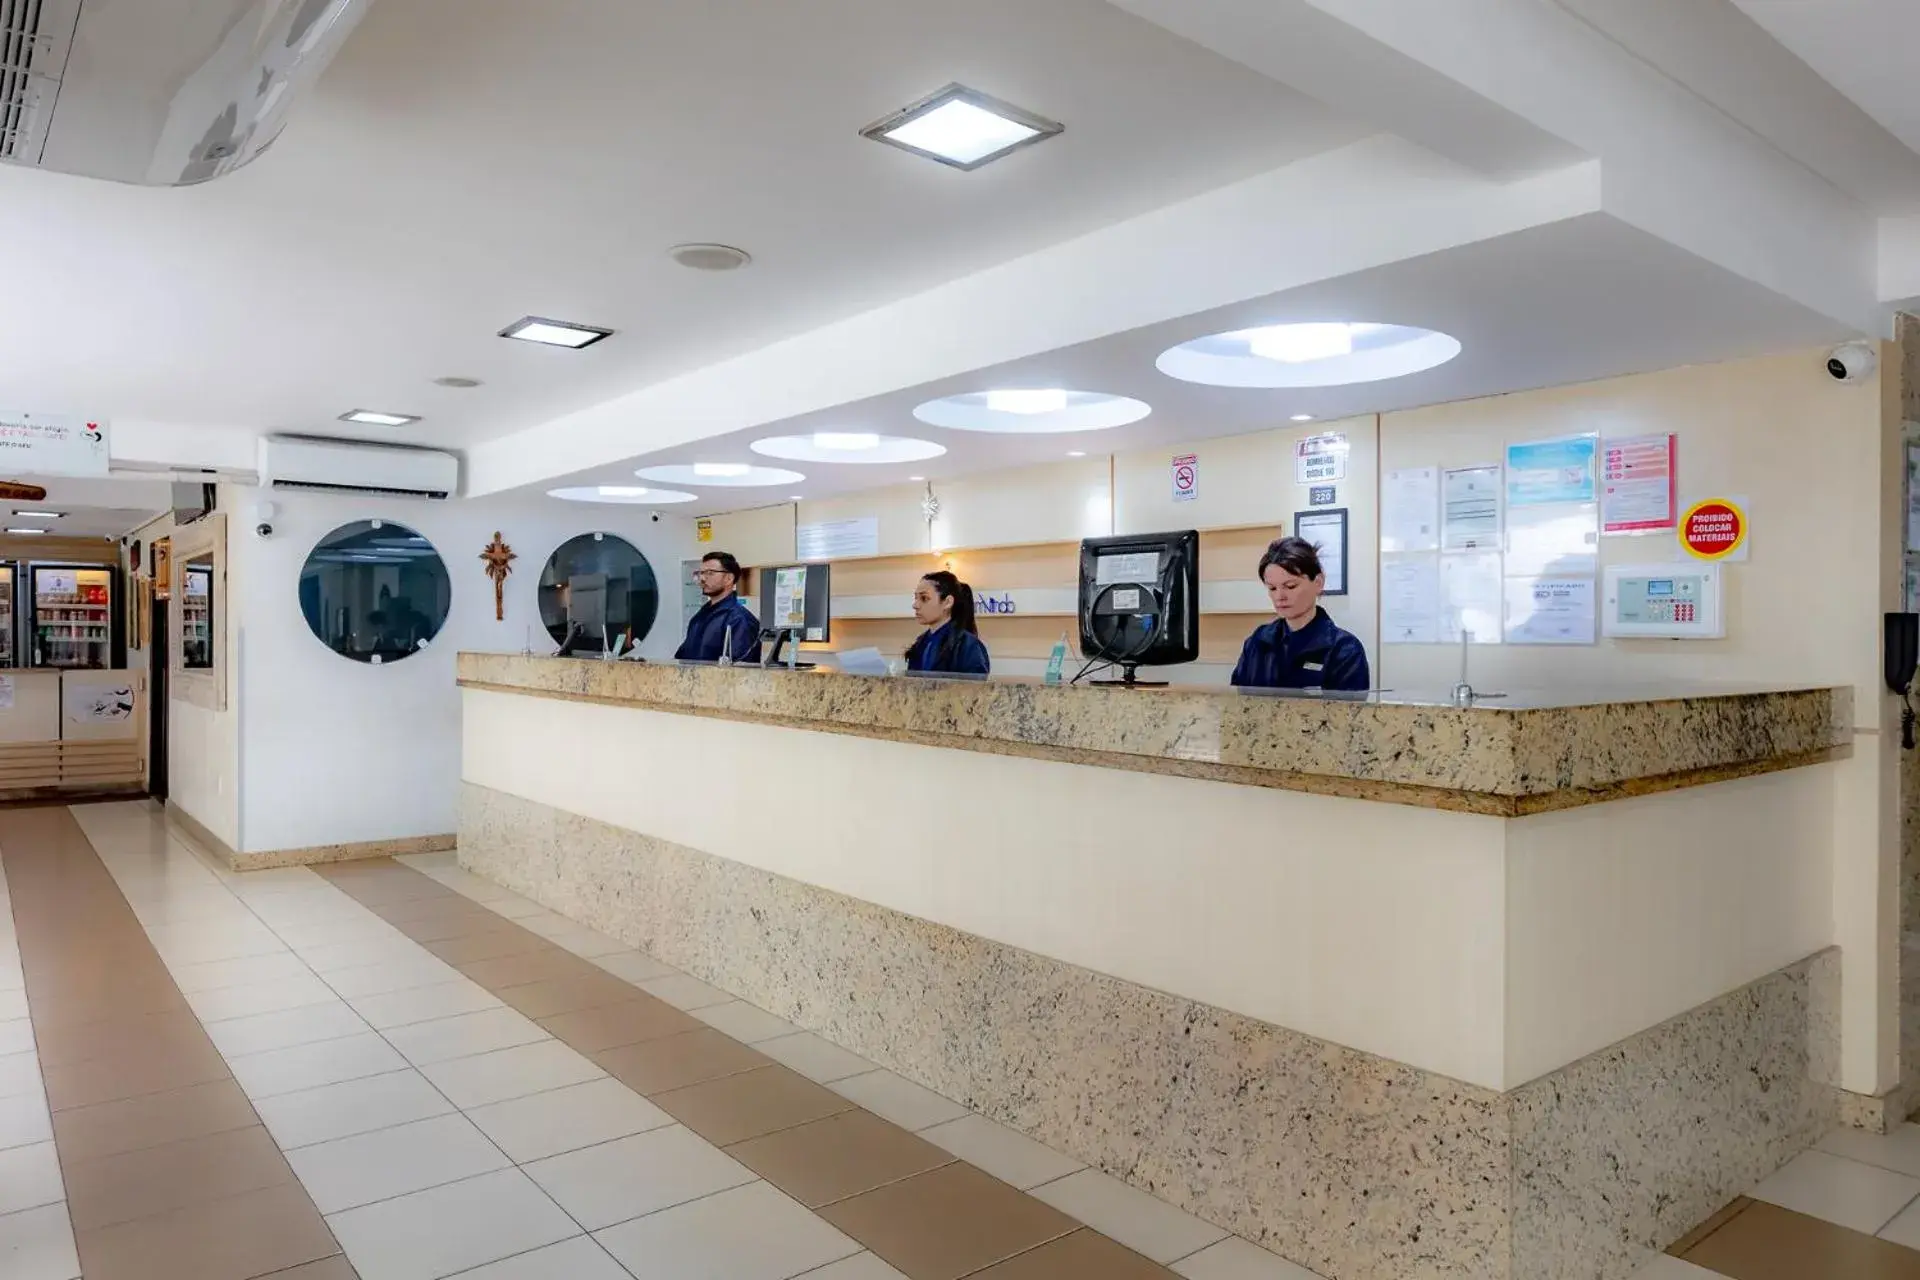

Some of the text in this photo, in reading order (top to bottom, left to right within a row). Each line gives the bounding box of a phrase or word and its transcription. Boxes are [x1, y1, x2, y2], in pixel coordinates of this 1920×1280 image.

[1314, 492, 1332, 502] 220
[1692, 513, 1733, 523] PROIBIDO
[1692, 523, 1732, 533] COLOCAR
[1688, 533, 1736, 543] MATERIAIS
